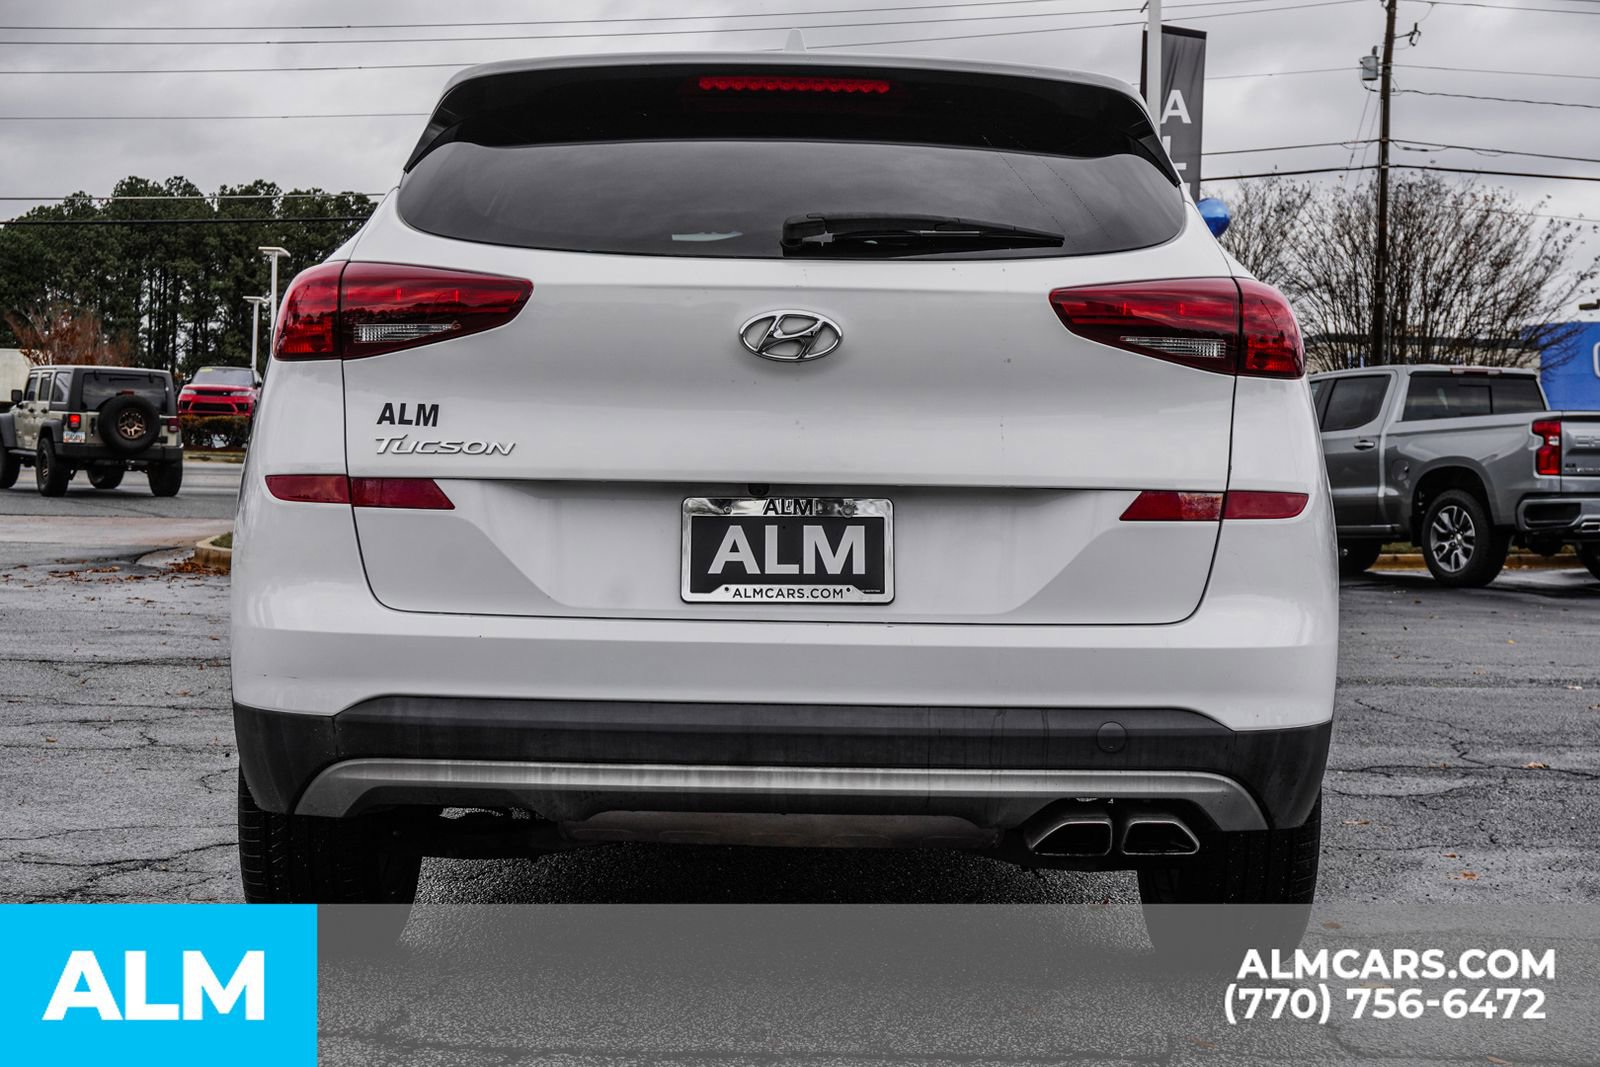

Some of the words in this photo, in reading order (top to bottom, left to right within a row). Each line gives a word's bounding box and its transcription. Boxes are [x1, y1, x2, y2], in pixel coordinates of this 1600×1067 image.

[1161, 89, 1191, 195] AL
[376, 402, 440, 427] ALM
[375, 434, 516, 456] TUCSON
[763, 498, 813, 516] ALM
[707, 525, 866, 575] ALM
[732, 588, 844, 599] ALMCARS.COM
